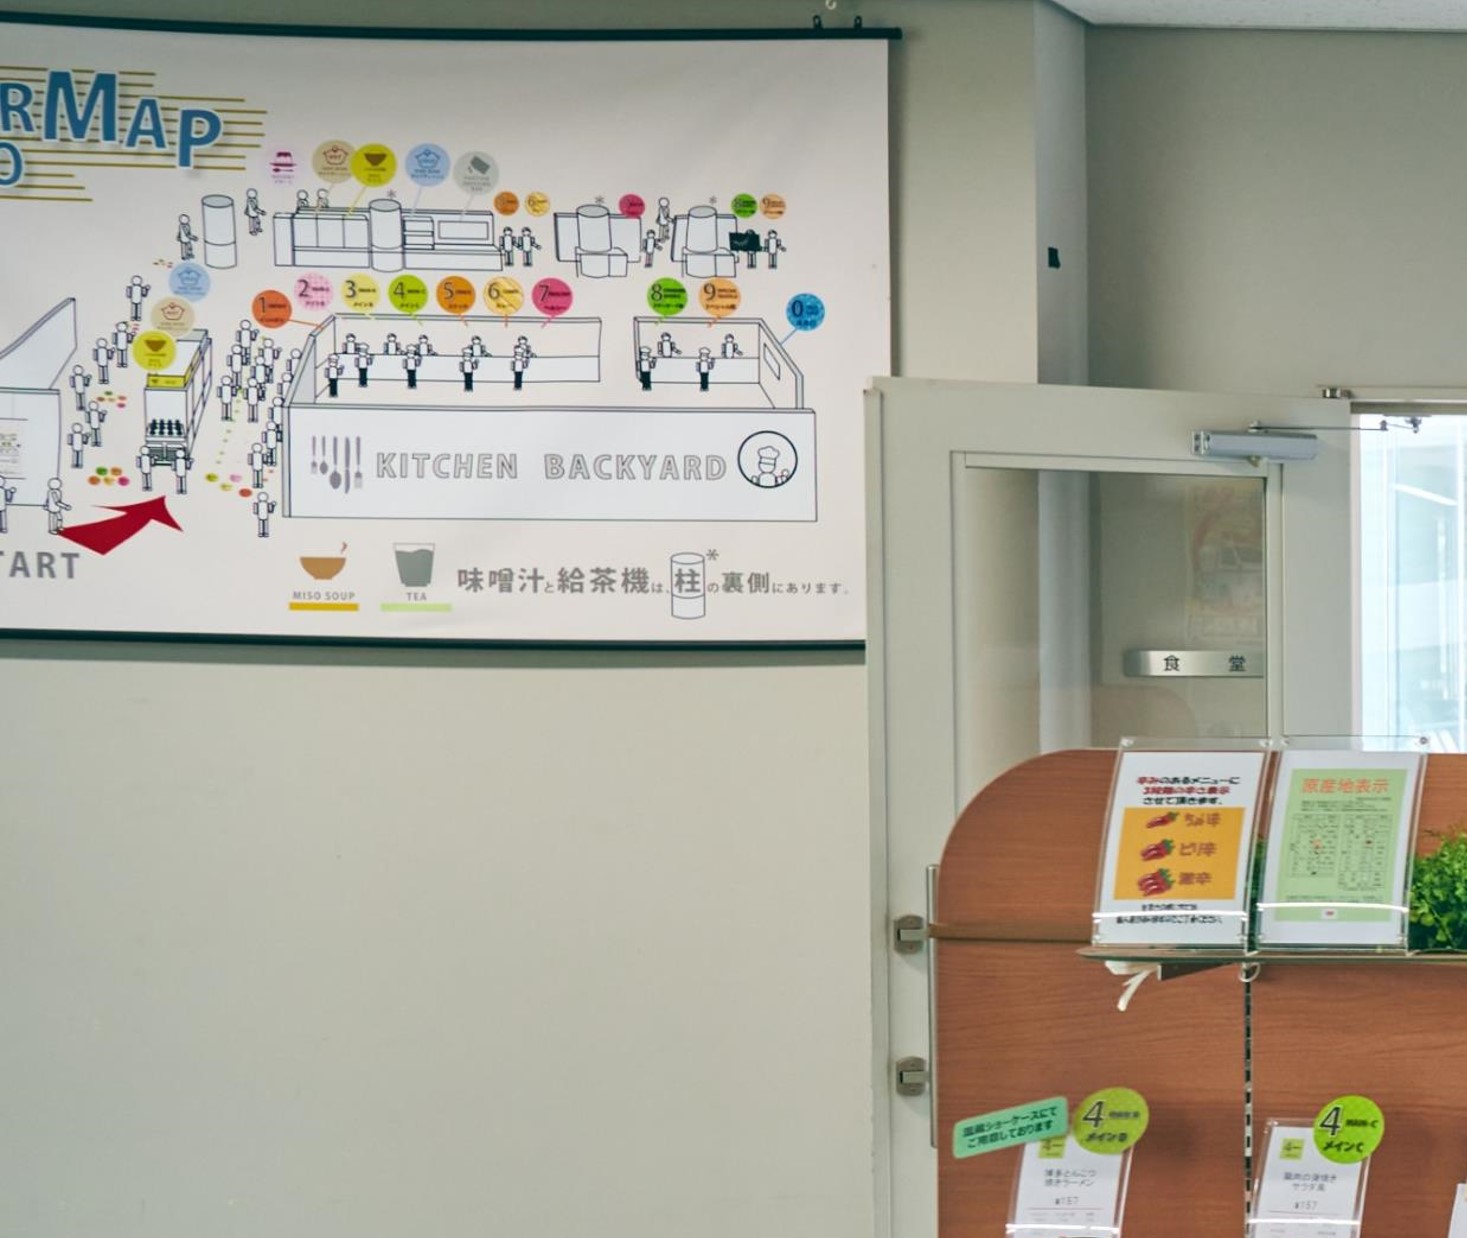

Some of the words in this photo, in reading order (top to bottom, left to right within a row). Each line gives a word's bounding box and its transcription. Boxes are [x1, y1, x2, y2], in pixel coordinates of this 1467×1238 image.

[298, 279, 310, 298] 2
[345, 280, 357, 298] 3
[393, 282, 405, 299] 4
[444, 282, 454, 299] 5
[488, 282, 500, 300] 6
[539, 285, 550, 302] 7
[651, 283, 662, 301] 8
[704, 283, 716, 301] 9
[258, 297, 266, 313] 1
[376, 451, 519, 480] KITCHEN
[543, 452, 728, 481] BACKYARD
[0, 550, 81, 580] ART
[327, 591, 356, 601] SOUP
[405, 592, 428, 602] TEA
[1163, 654, 1247, 673] 食堂
[1302, 777, 1389, 794] 原産地表示
[1082, 1100, 1104, 1129] 4
[1319, 1106, 1343, 1137] 4
